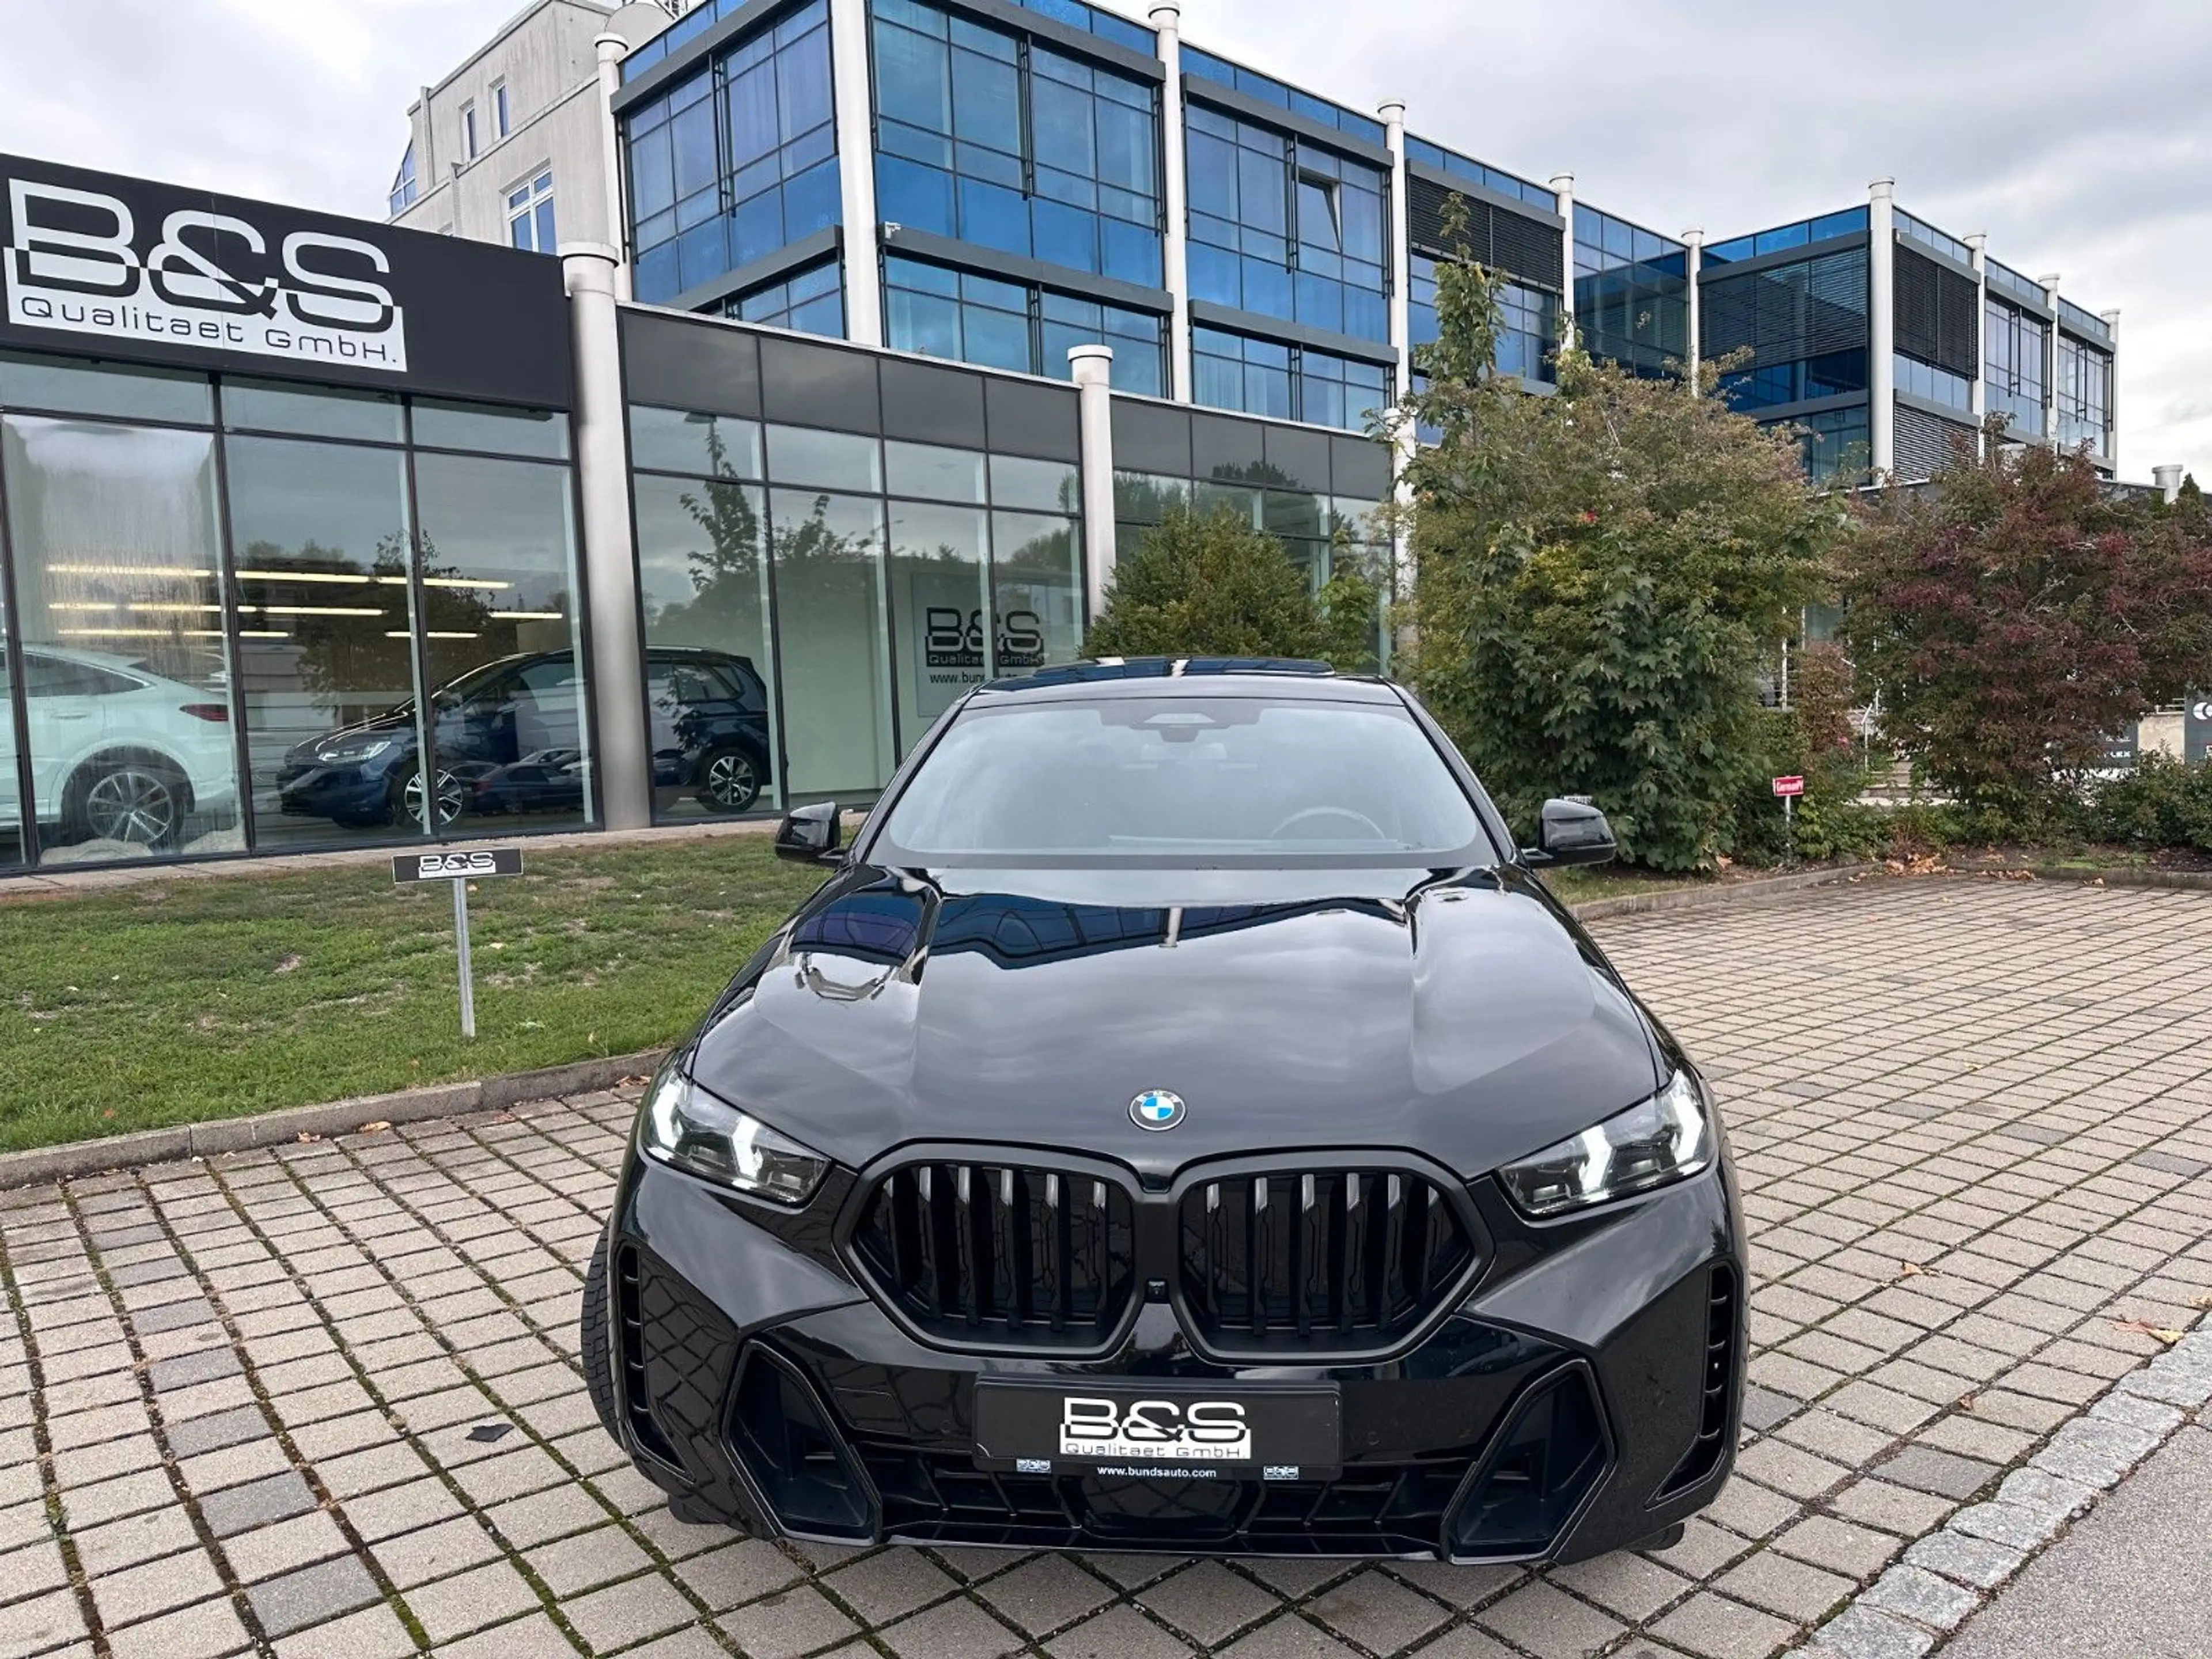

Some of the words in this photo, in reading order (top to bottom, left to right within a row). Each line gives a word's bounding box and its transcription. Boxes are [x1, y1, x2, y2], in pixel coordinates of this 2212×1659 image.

[9, 178, 394, 333] B&S
[21, 296, 243, 343] Qualitaet
[265, 328, 397, 363] GmbH.
[926, 607, 1041, 653] B&S
[929, 654, 984, 665] Qualita
[419, 852, 494, 872] B&S
[1065, 1397, 1246, 1444] B&S
[1065, 1442, 1165, 1457] Qualitaet
[1097, 1465, 1217, 1478] www.bundsauto.com
